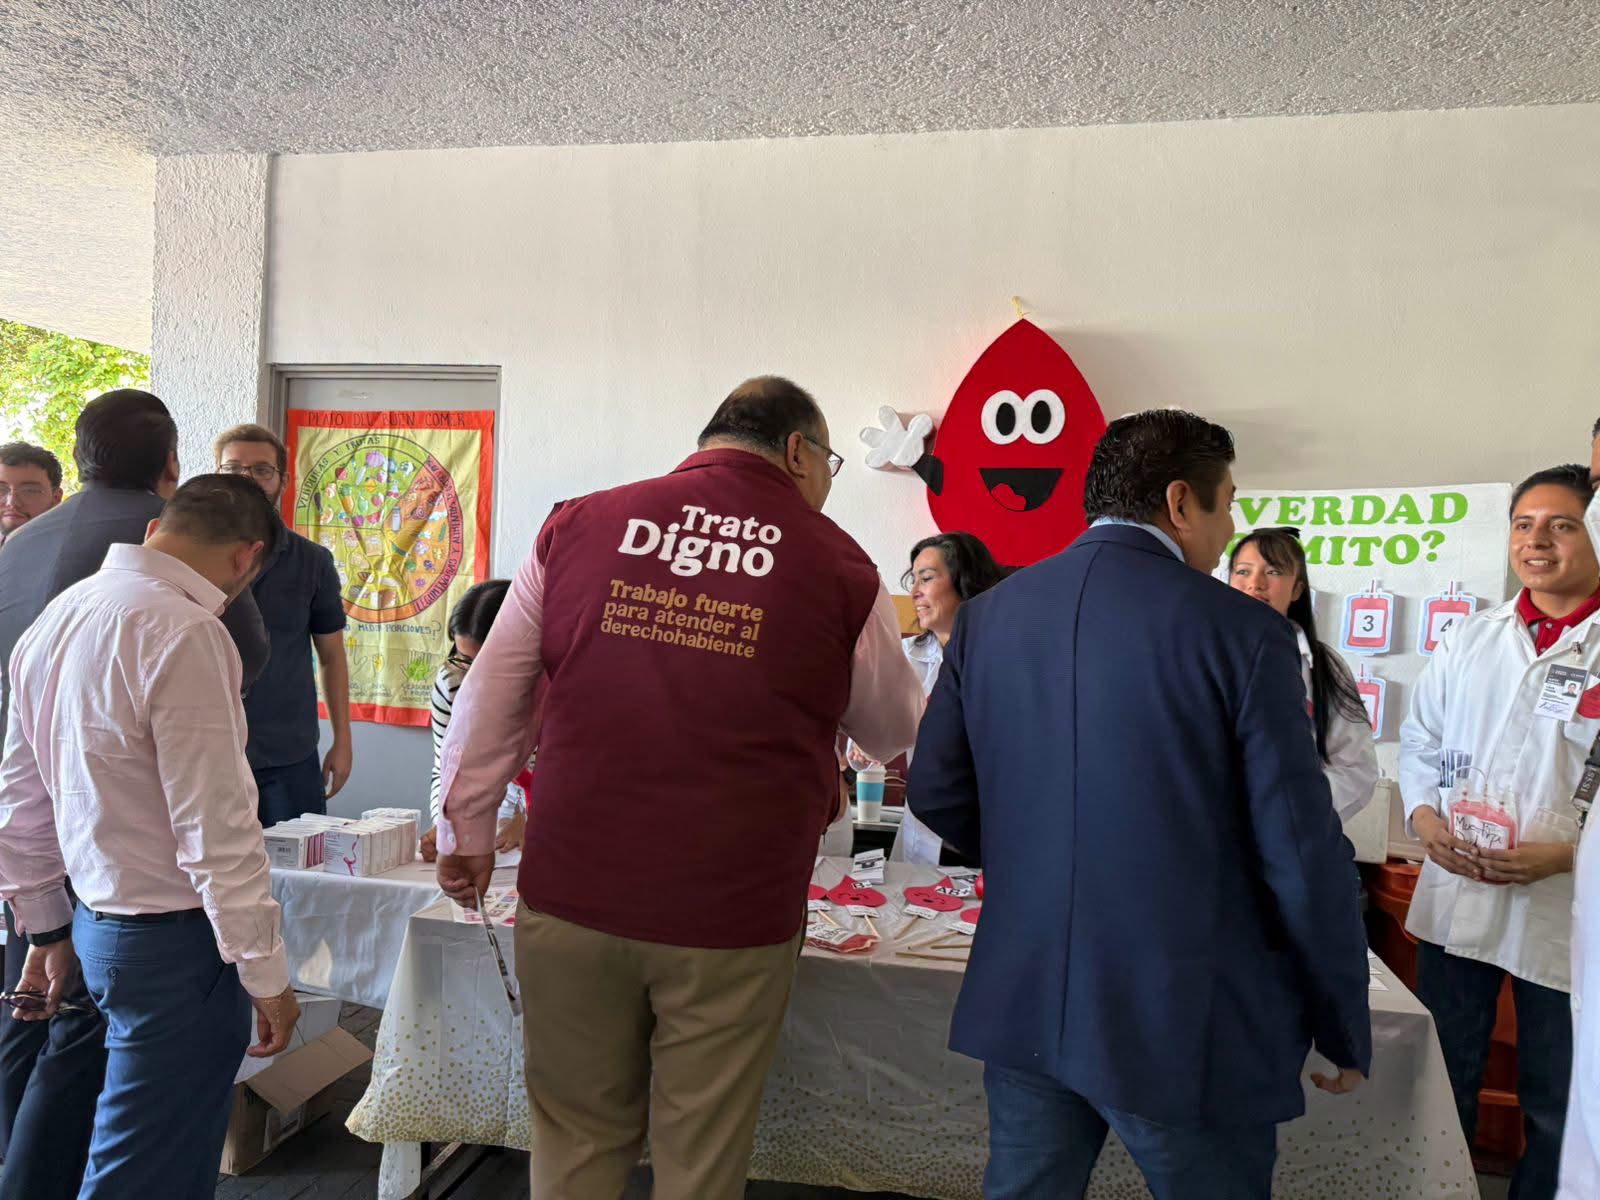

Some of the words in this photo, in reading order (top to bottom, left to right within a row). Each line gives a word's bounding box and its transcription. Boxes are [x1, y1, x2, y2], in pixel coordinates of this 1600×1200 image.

[308, 411, 344, 427] PLATO
[353, 412, 376, 427] DEL
[382, 411, 416, 427] BUEN
[425, 411, 465, 428] COMER
[297, 457, 329, 508] VERDURAS
[333, 448, 341, 457] Y
[345, 436, 381, 451] FRUTAS
[682, 505, 782, 545] Trato
[1233, 492, 1468, 526] VERDAD
[617, 518, 775, 577] Digno
[415, 558, 458, 612] LEGUMINOSAS
[610, 579, 689, 610] Trabajo
[693, 593, 764, 622] fuerte
[600, 618, 756, 658] derechohabiente
[602, 602, 649, 621] para
[655, 608, 736, 636] atender
[740, 623, 760, 641] al
[1362, 615, 1375, 632] 3
